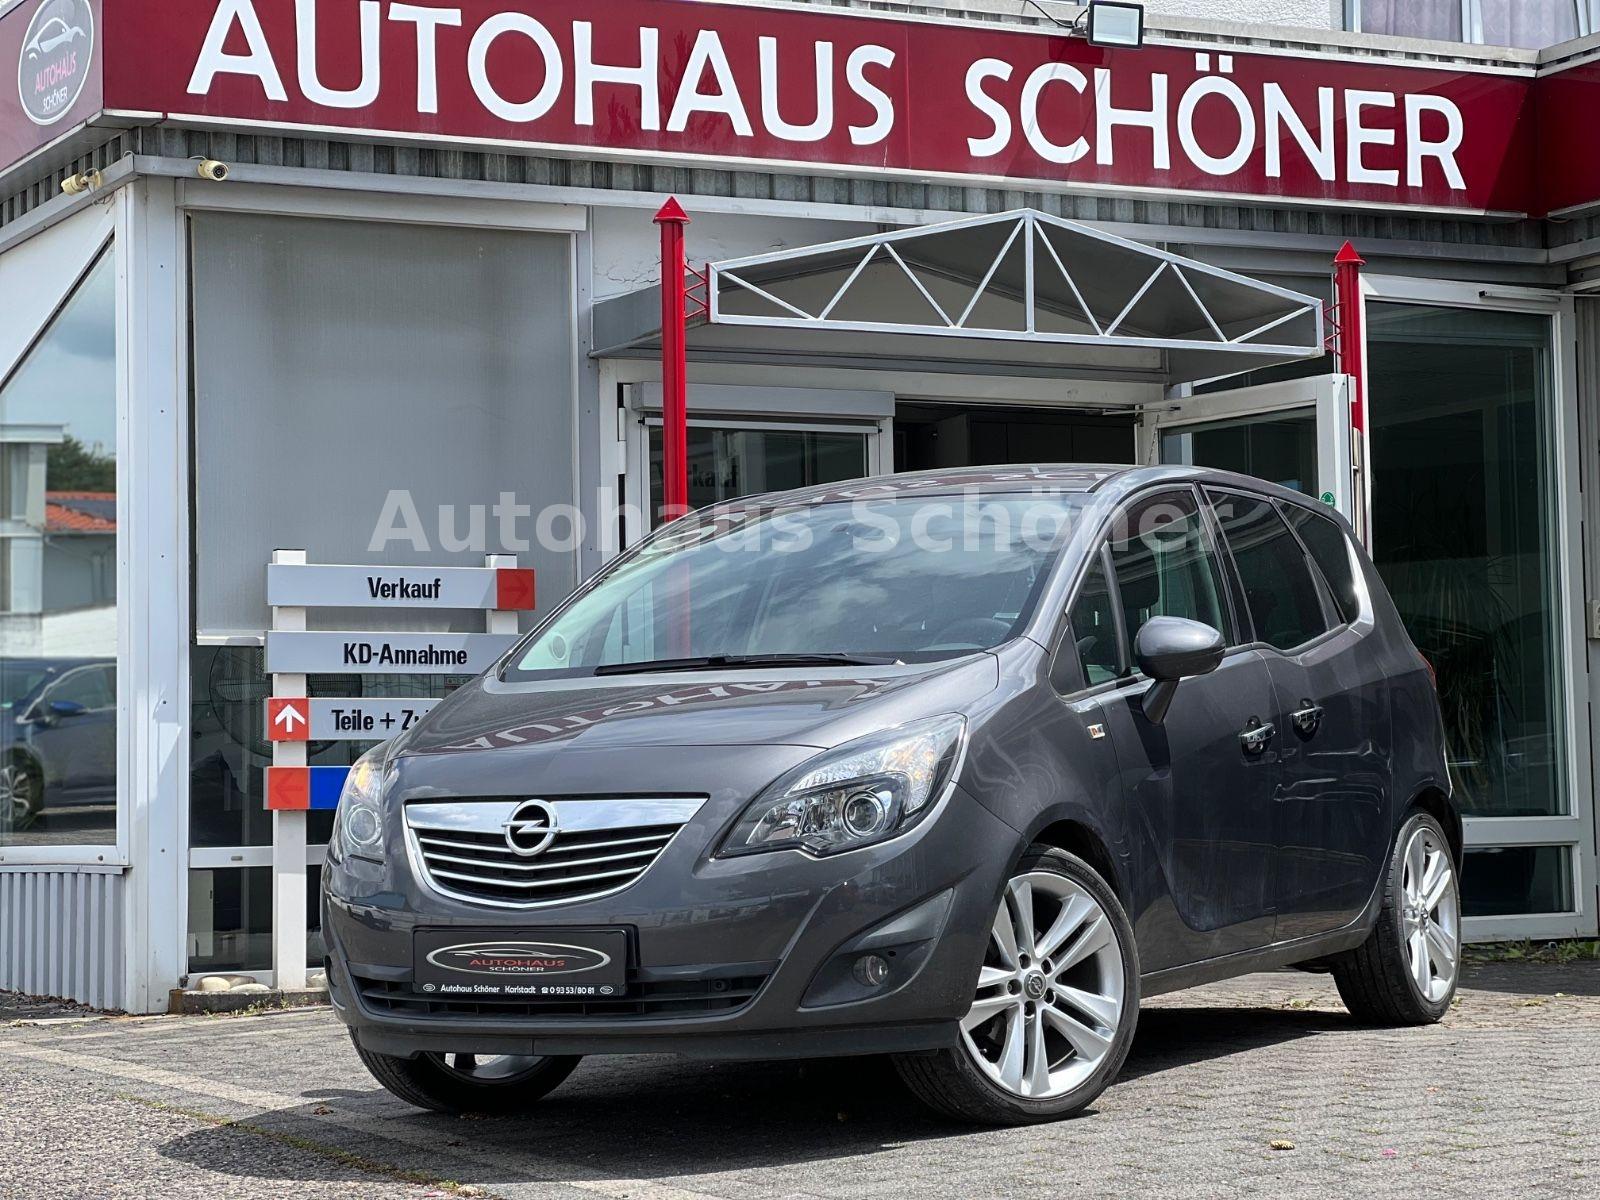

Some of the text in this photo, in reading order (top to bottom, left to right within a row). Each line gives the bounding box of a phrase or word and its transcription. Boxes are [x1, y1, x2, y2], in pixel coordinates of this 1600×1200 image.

[35, 50, 77, 95] AUTOHAUS
[43, 86, 68, 113] SCHÖNER
[186, 0, 1467, 190] AUTOHAUS SCHÖNER
[367, 577, 442, 599] Verkauf
[343, 643, 468, 665] KD-Annahme
[331, 709, 374, 731] Teile
[380, 712, 395, 729] +
[469, 958, 566, 967] AUTOHAUS
[440, 984, 473, 993] Autohaus
[473, 984, 500, 993] Schöner
[504, 985, 536, 994] Karlstadt
